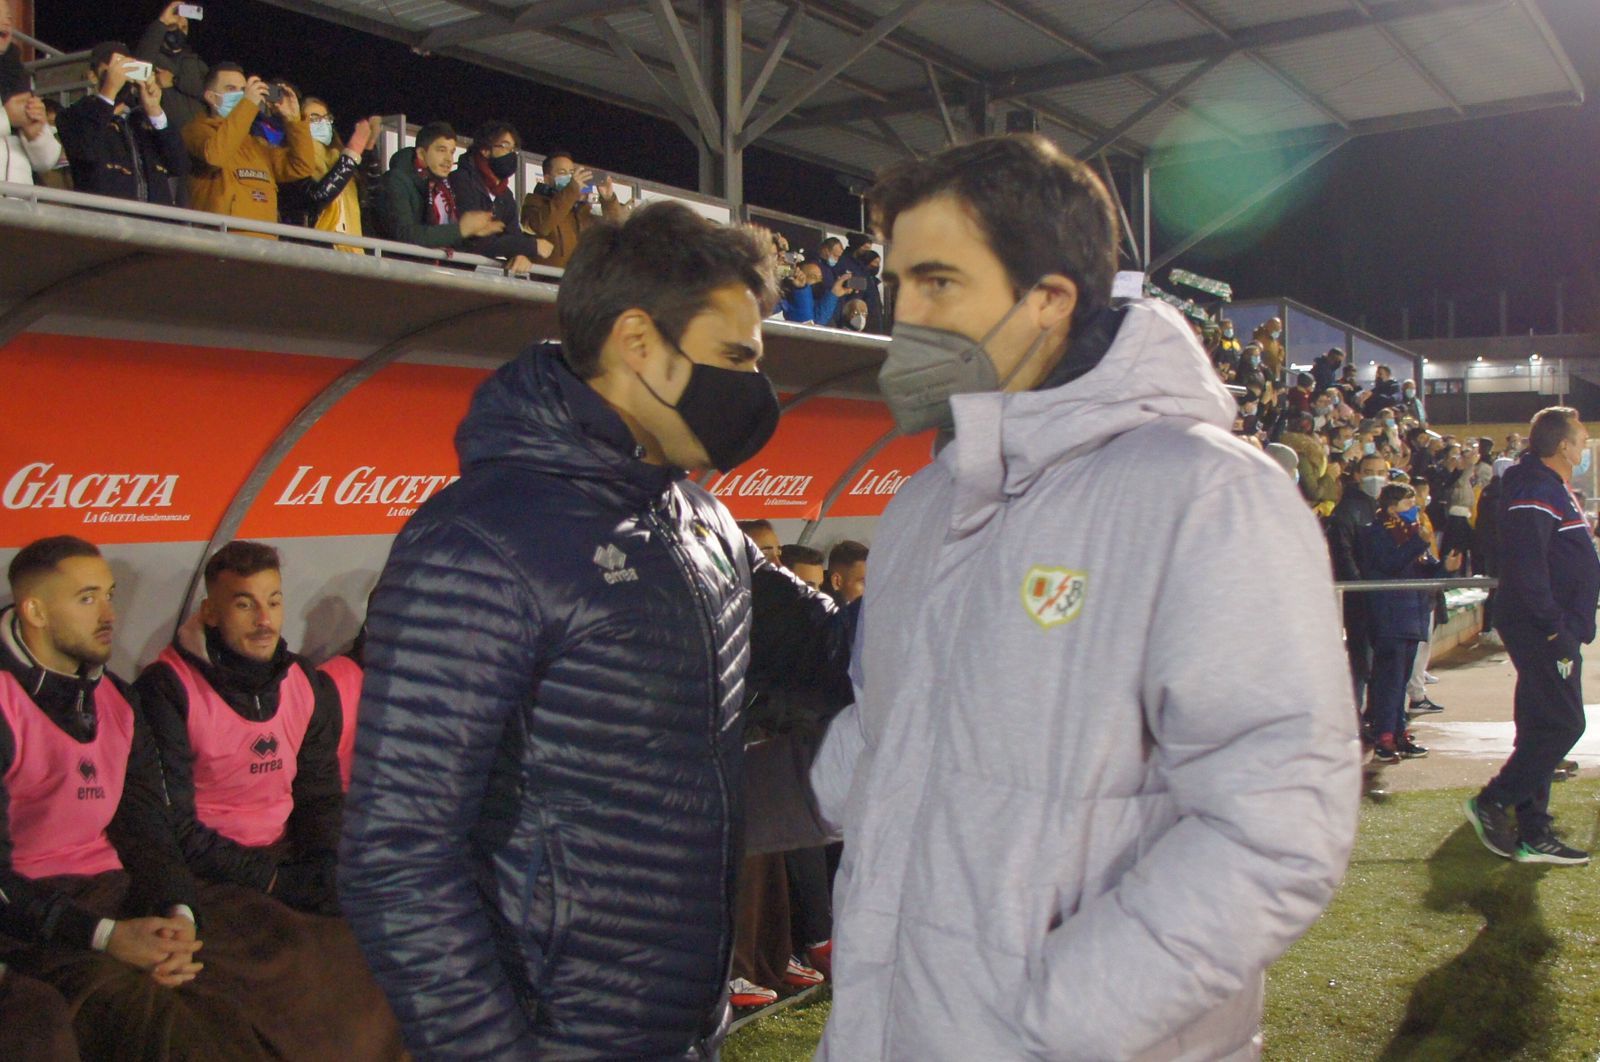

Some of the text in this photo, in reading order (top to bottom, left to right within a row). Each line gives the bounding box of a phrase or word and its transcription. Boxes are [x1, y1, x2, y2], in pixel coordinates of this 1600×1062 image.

[2, 462, 180, 510] GACETA
[274, 465, 332, 506] LA
[738, 468, 813, 497] GACETA
[874, 469, 912, 495] GAC
